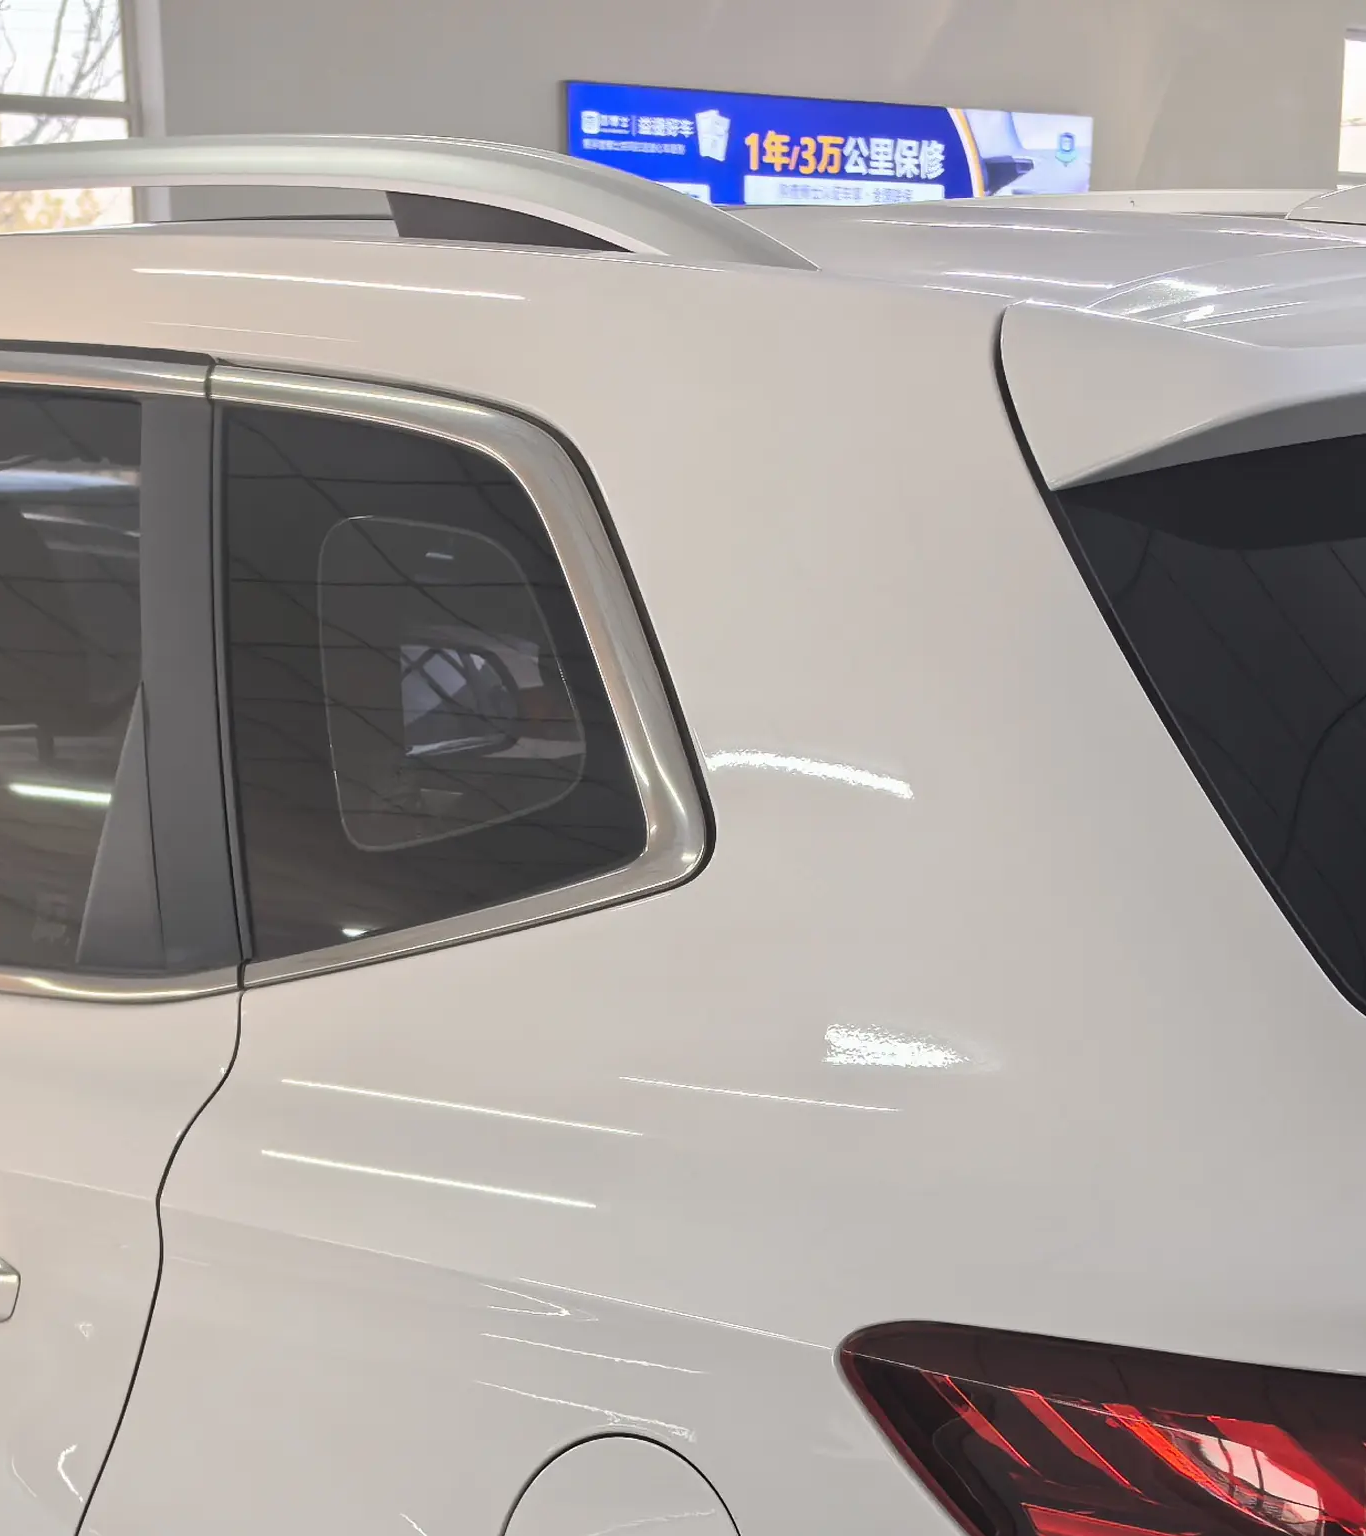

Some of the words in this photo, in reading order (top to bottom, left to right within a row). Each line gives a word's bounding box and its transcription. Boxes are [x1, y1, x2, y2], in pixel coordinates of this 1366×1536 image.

[744, 130, 946, 180] 1年/3万公里保修
